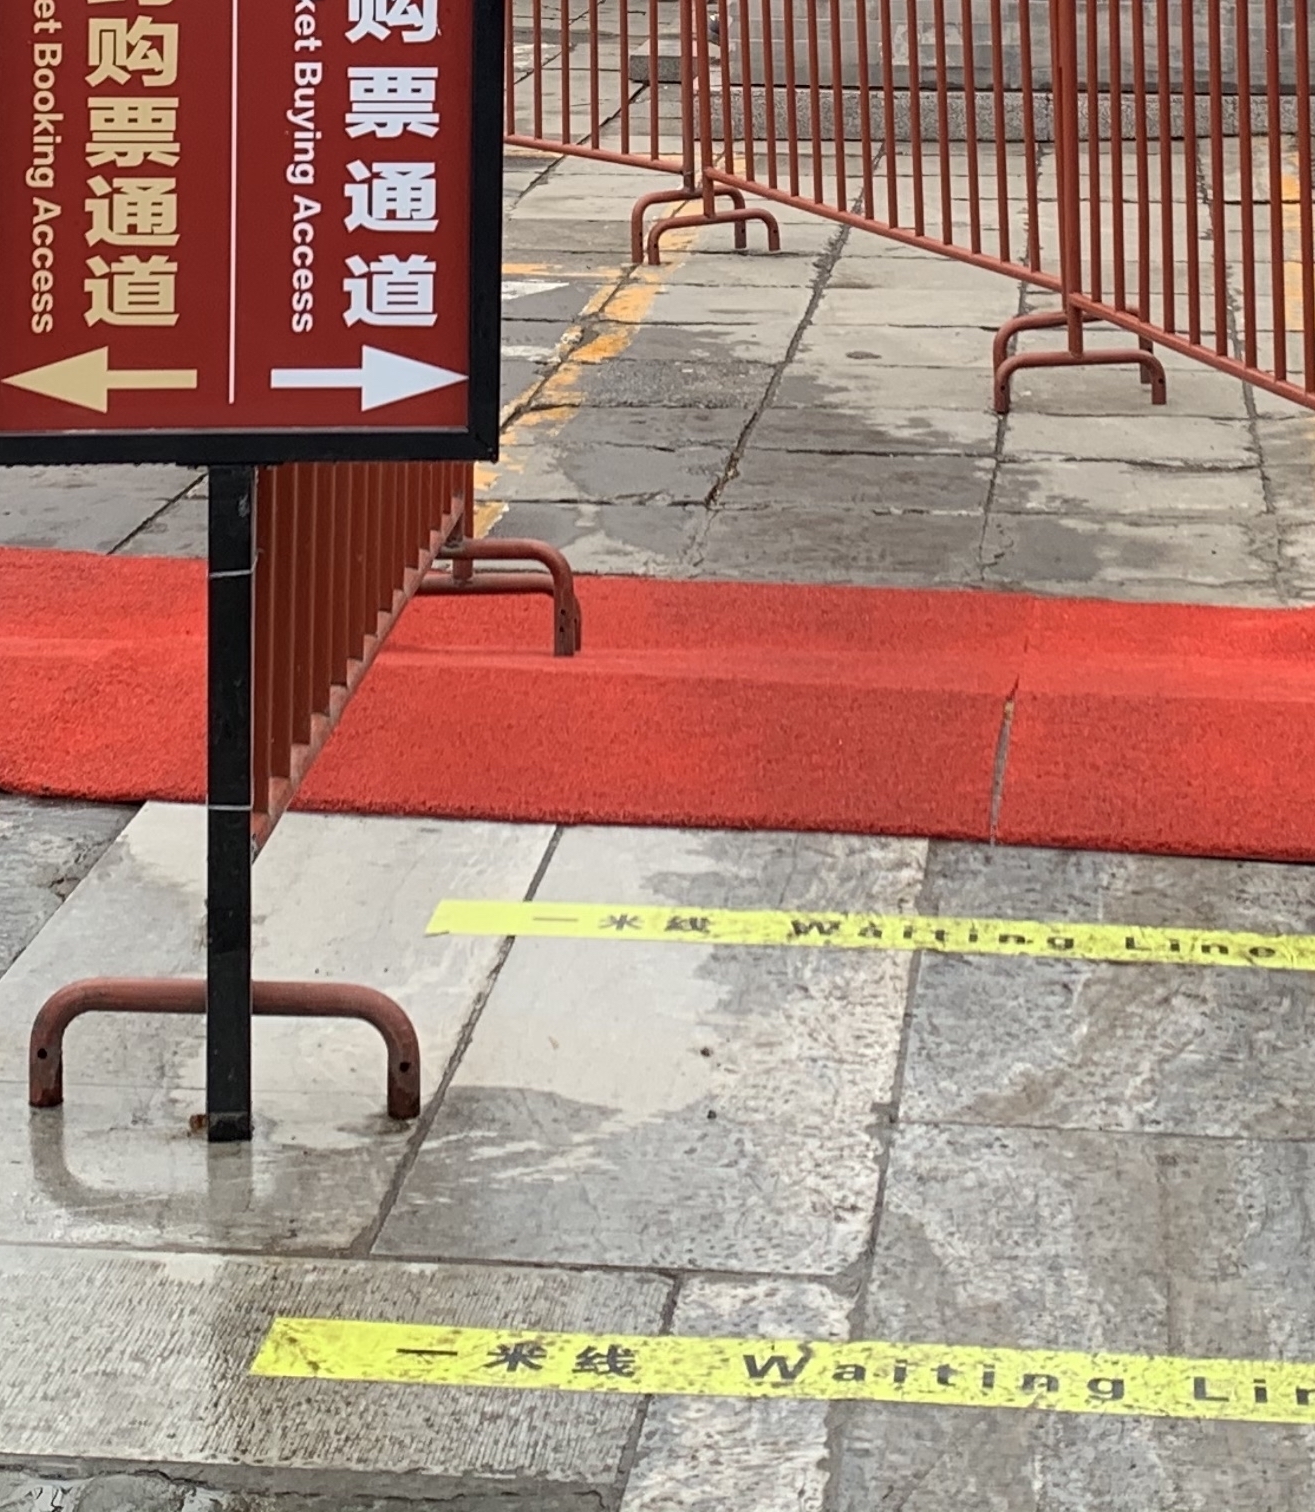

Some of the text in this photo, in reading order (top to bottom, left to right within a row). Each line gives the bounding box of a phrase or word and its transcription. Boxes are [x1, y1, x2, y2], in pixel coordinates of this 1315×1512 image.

[26, 43, 64, 188] Booking
[286, 62, 323, 185] Buying
[31, 197, 61, 334] Access
[291, 194, 322, 333] Access
[532, 913, 1276, 959] 一米线 Waiting Line
[396, 1343, 637, 1379] 一米线
[742, 1349, 1126, 1402] Waiting
